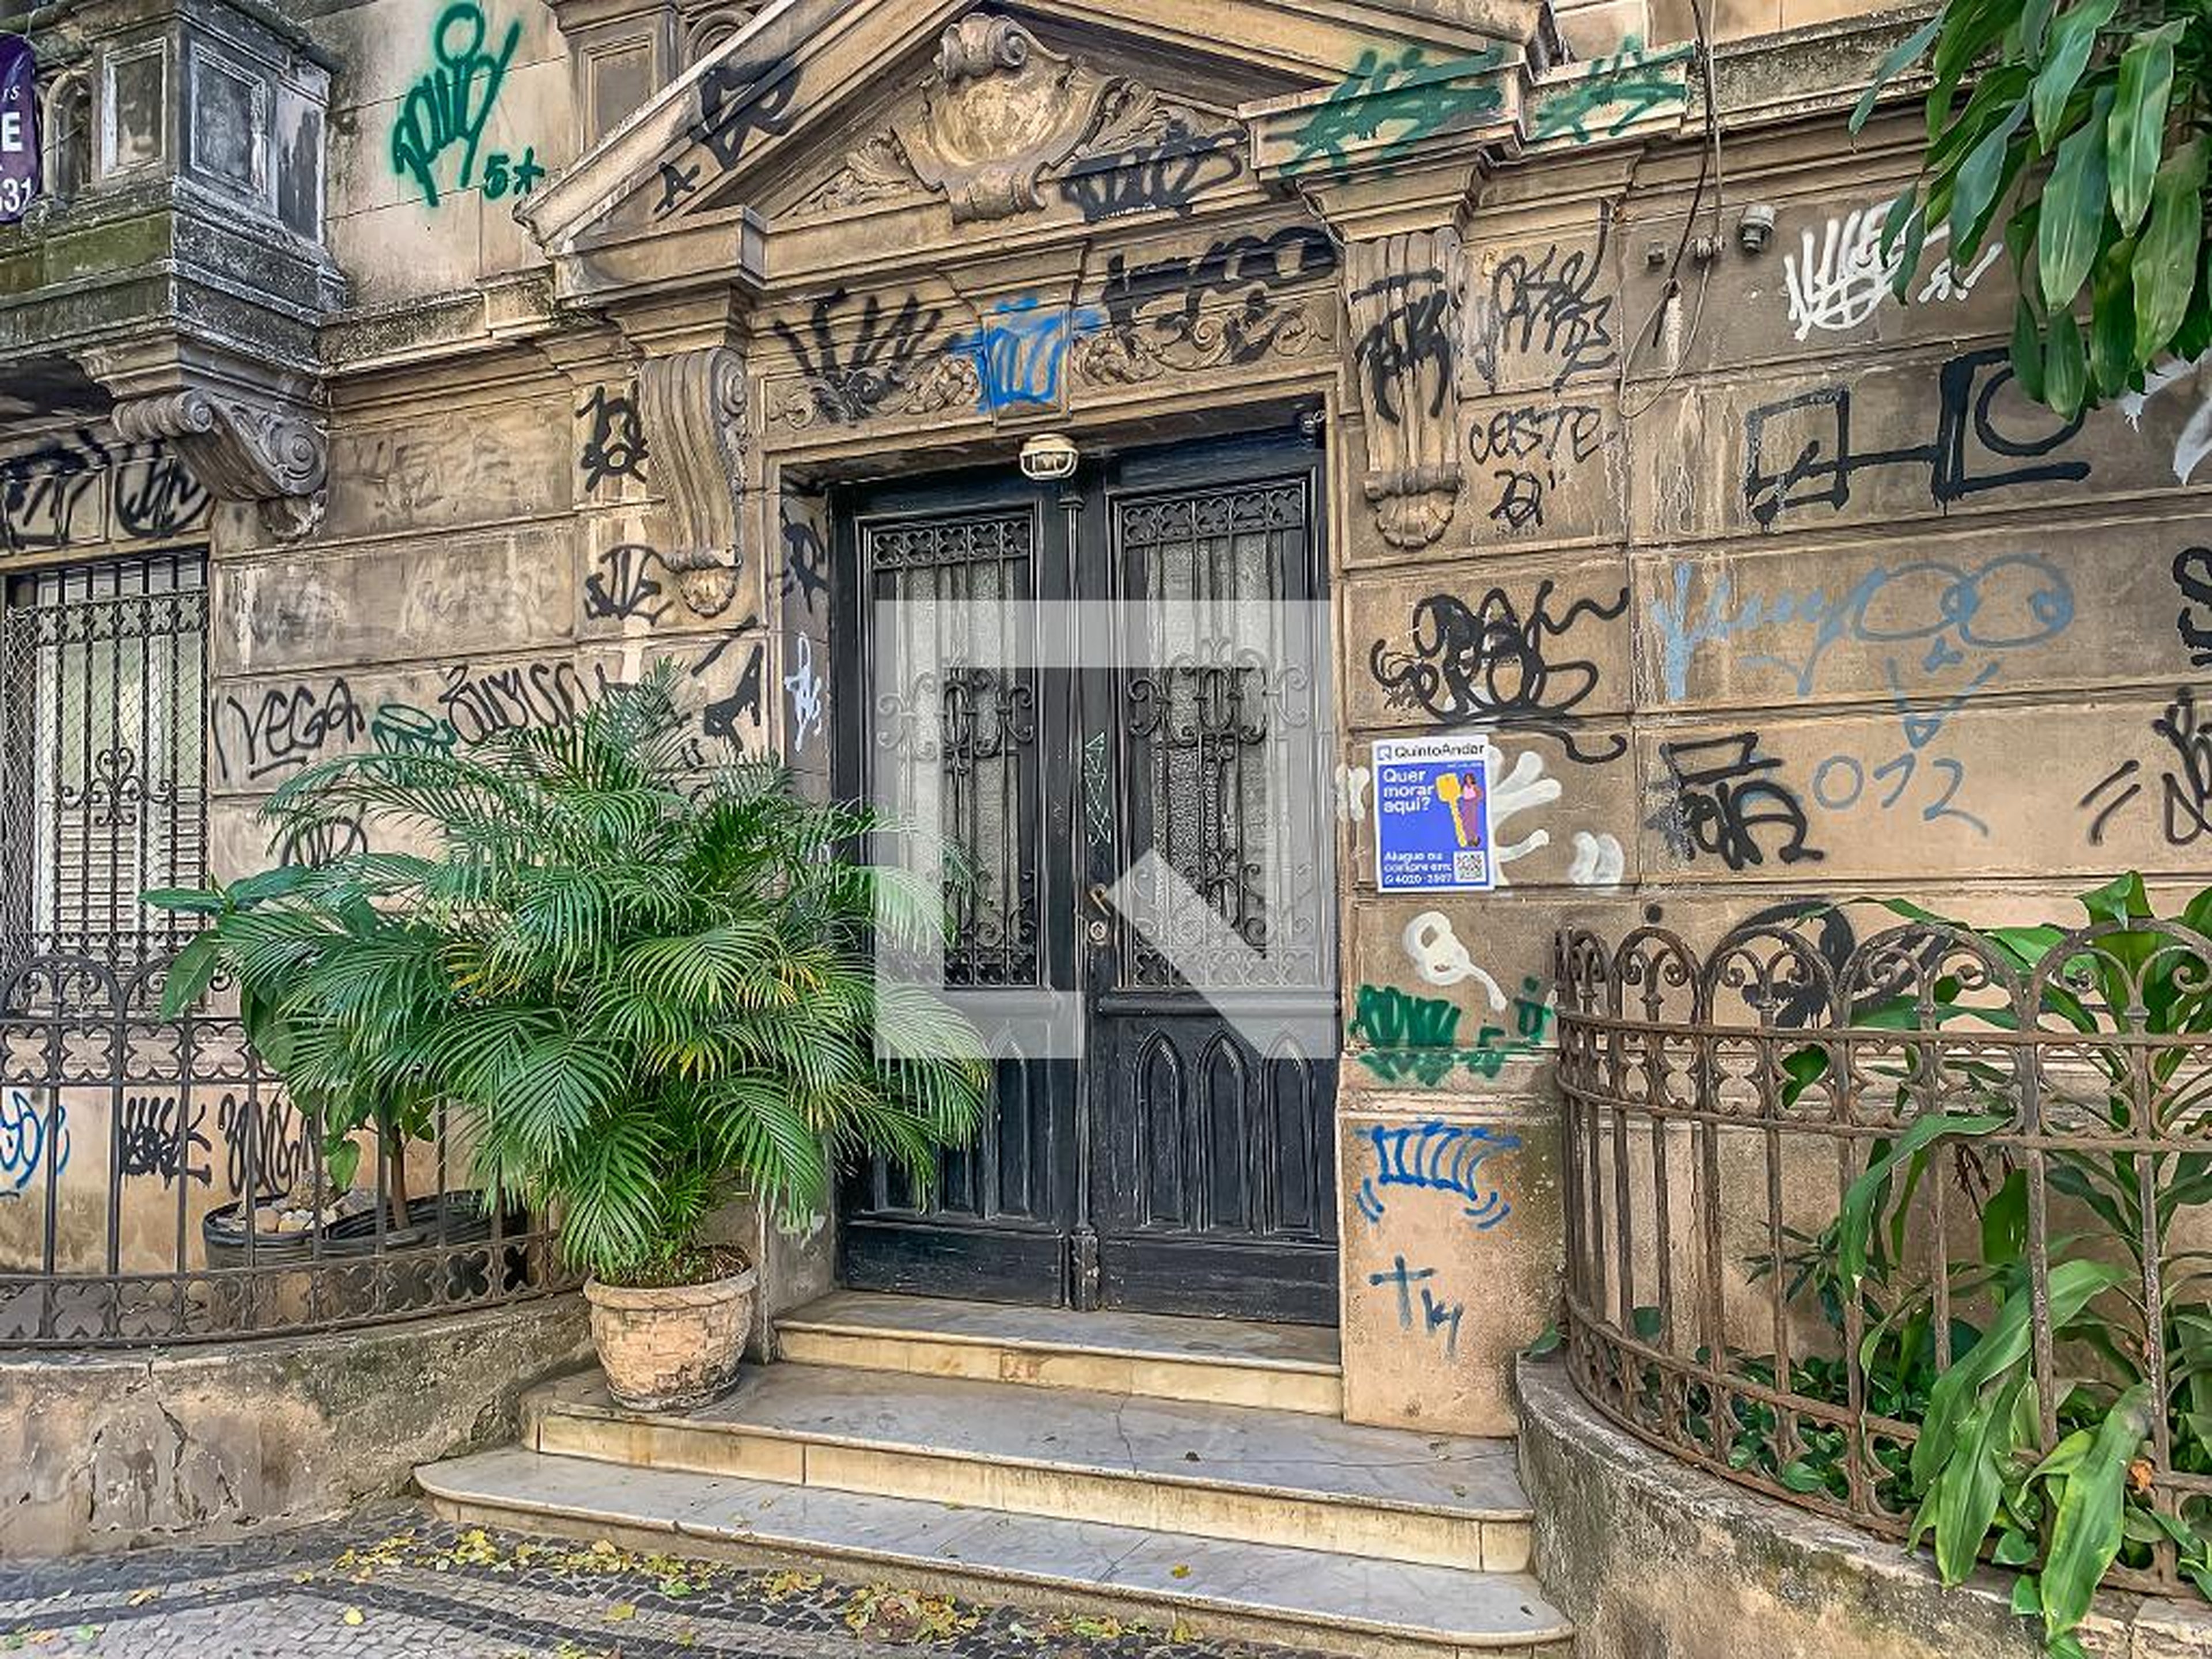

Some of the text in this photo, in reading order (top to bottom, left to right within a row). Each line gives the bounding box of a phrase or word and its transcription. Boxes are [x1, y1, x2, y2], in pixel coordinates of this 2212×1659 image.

[1395, 743, 1484, 759] QuintoAndar
[1383, 767, 1426, 783] Quer
[1383, 785, 1435, 798] morar
[1383, 797, 1431, 815] aqui?
